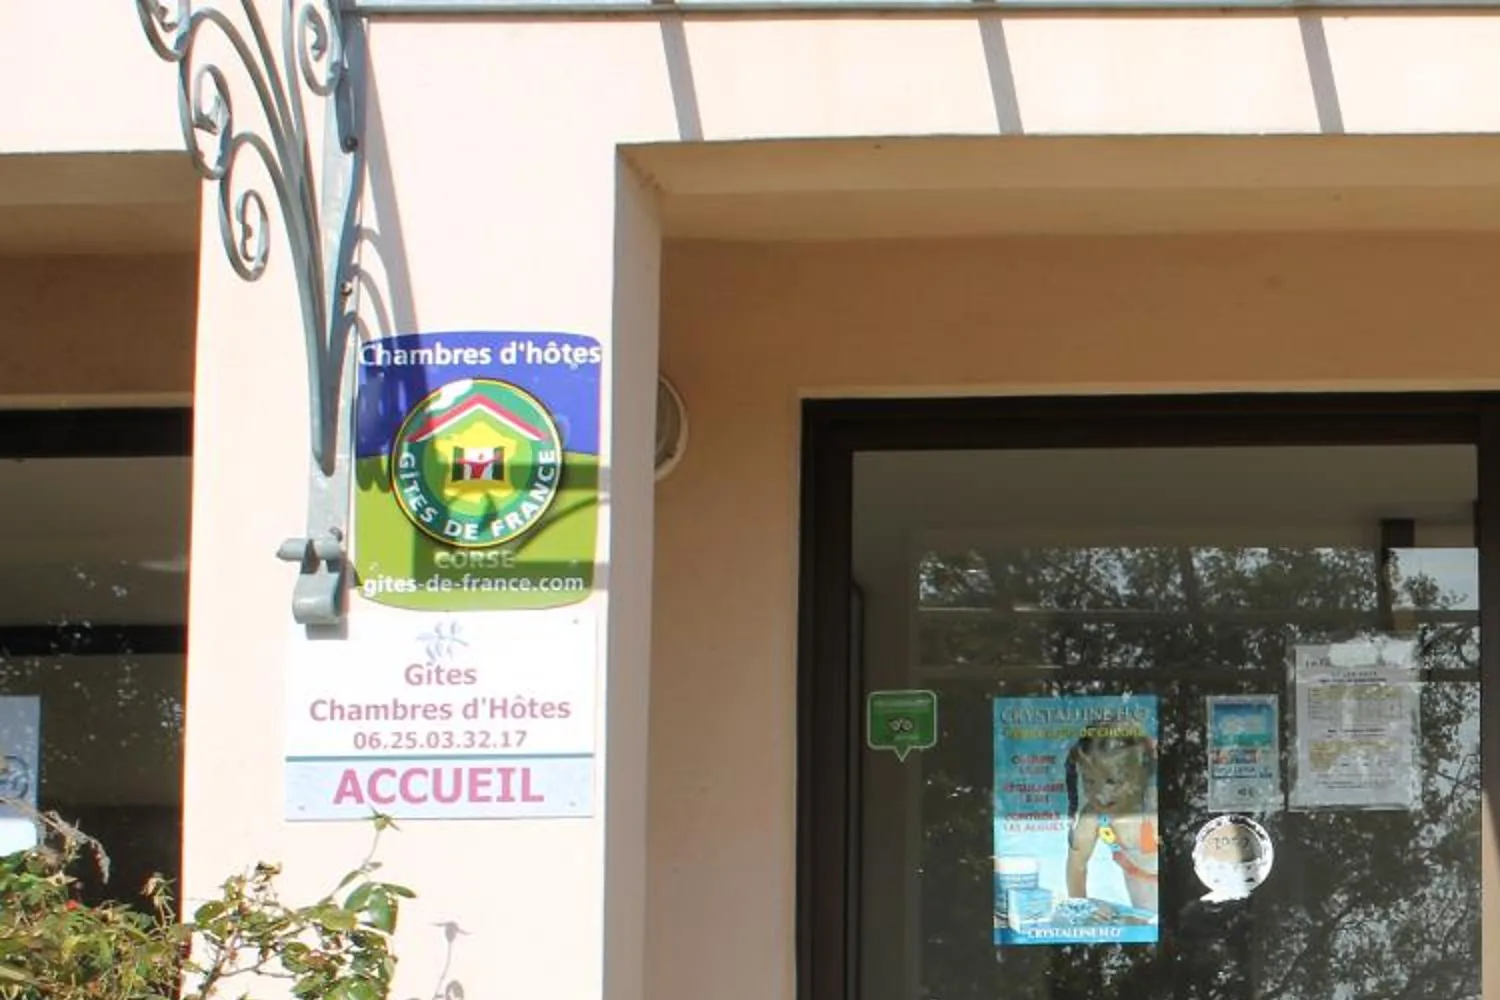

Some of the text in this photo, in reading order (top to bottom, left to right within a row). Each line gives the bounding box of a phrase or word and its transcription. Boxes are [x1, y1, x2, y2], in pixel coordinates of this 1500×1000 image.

[359, 340, 603, 366] Chambres d'hôtes
[445, 520, 480, 540] DE
[490, 448, 555, 537] FRANCE
[433, 550, 516, 570] CORSE
[404, 661, 478, 686] Gîtes
[309, 693, 572, 722] Chambres d'Hôtes
[352, 729, 528, 751] 06.25.03.32.17
[332, 766, 545, 806] ACCUEIL
